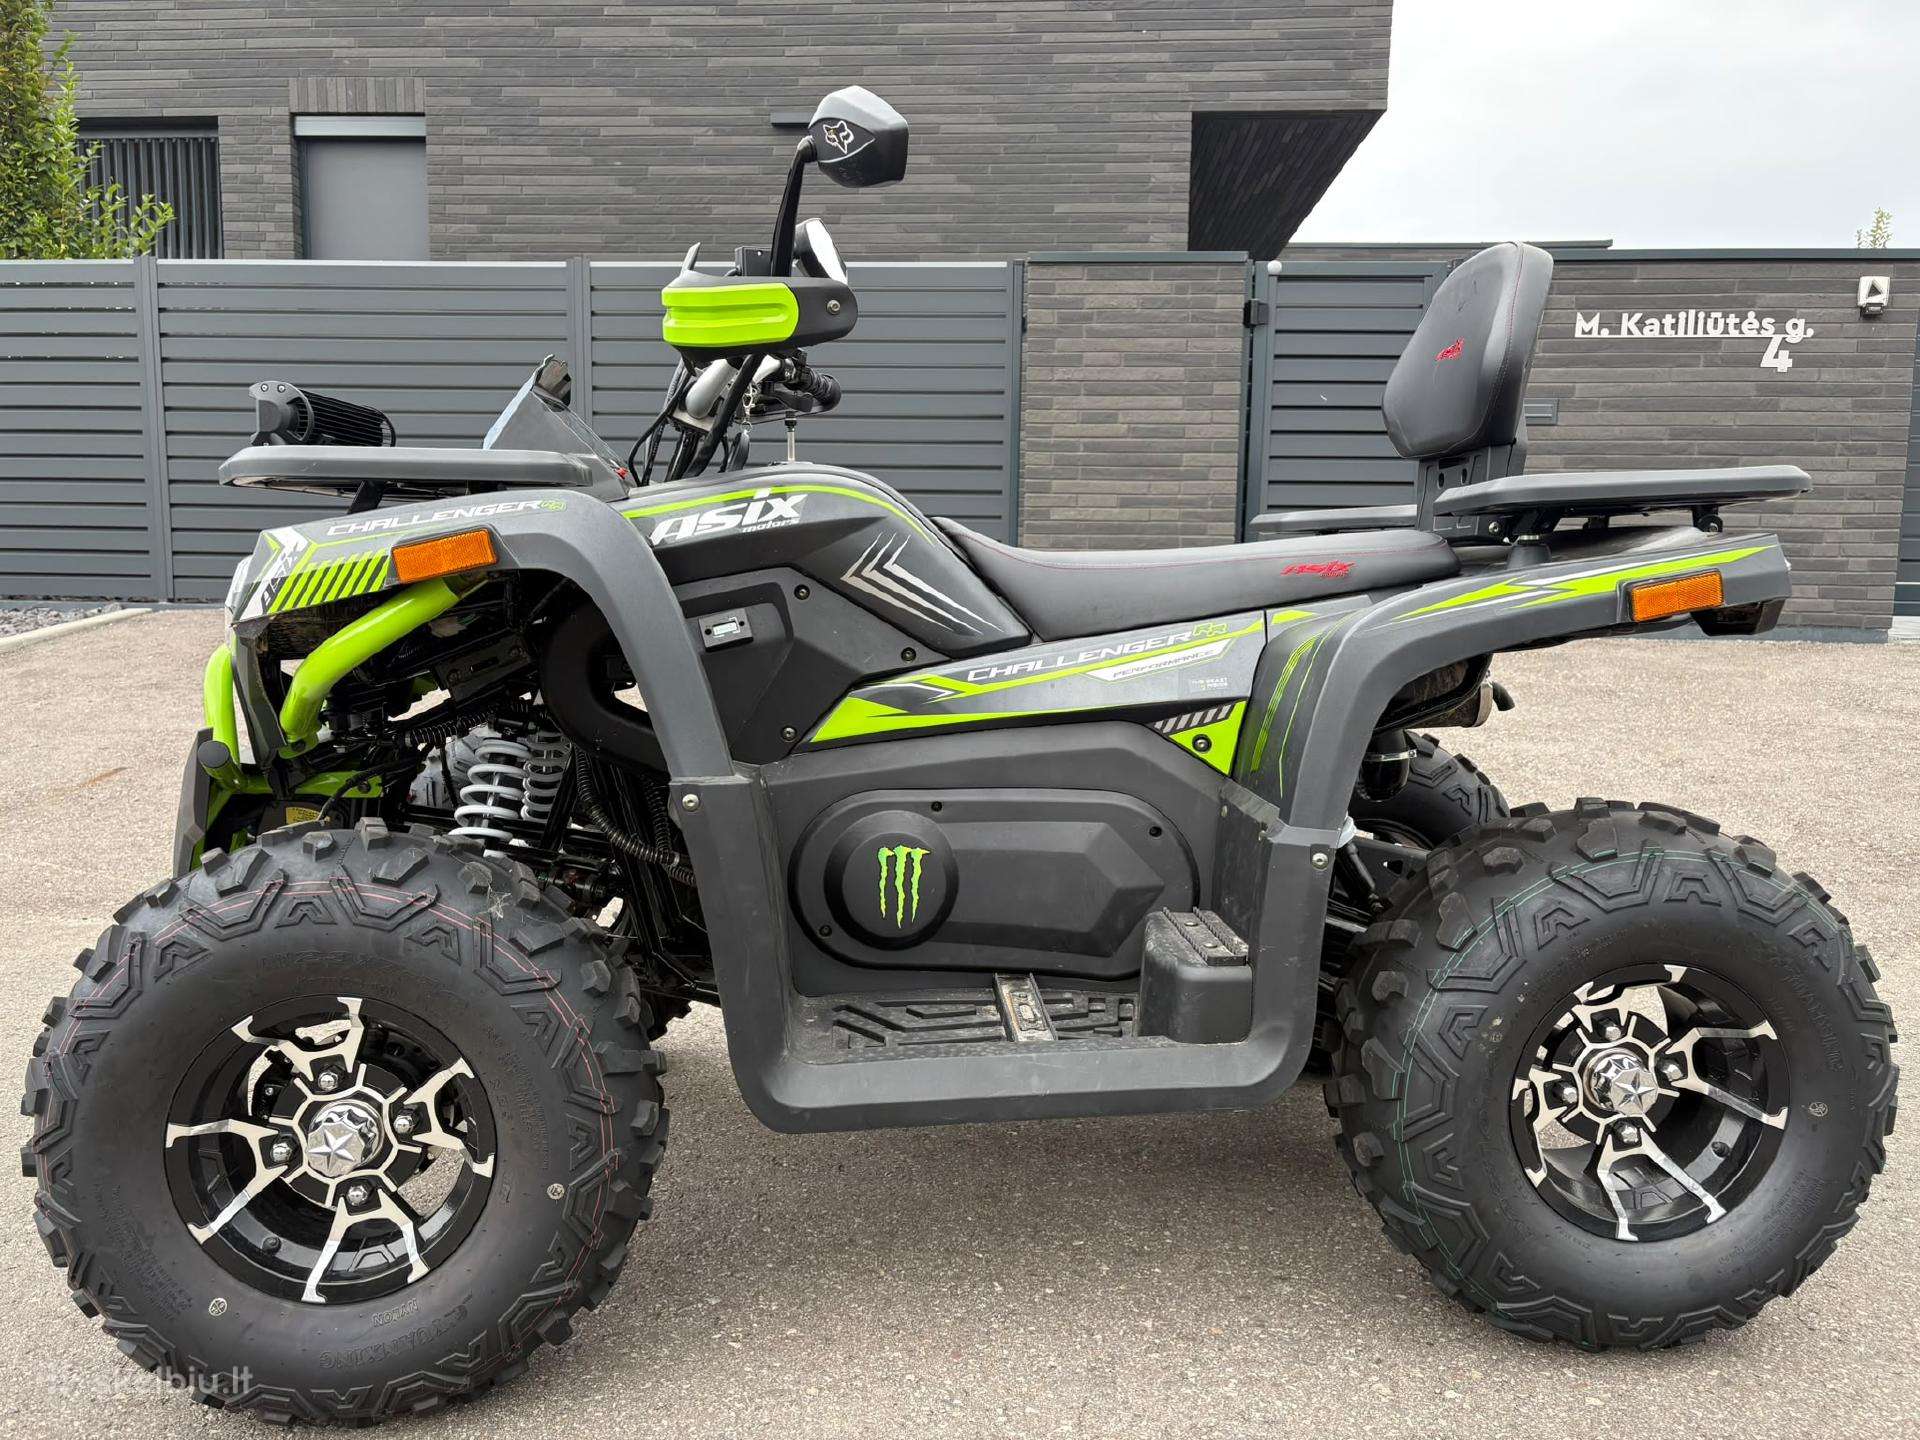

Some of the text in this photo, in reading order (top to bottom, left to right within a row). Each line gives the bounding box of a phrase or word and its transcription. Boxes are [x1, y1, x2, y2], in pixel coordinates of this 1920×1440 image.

[1574, 309, 1815, 343] M. Katiliūtės g.
[1760, 335, 1793, 373] 4
[326, 499, 541, 537] CHALLENGER
[967, 630, 1194, 682] CHALLENGER
